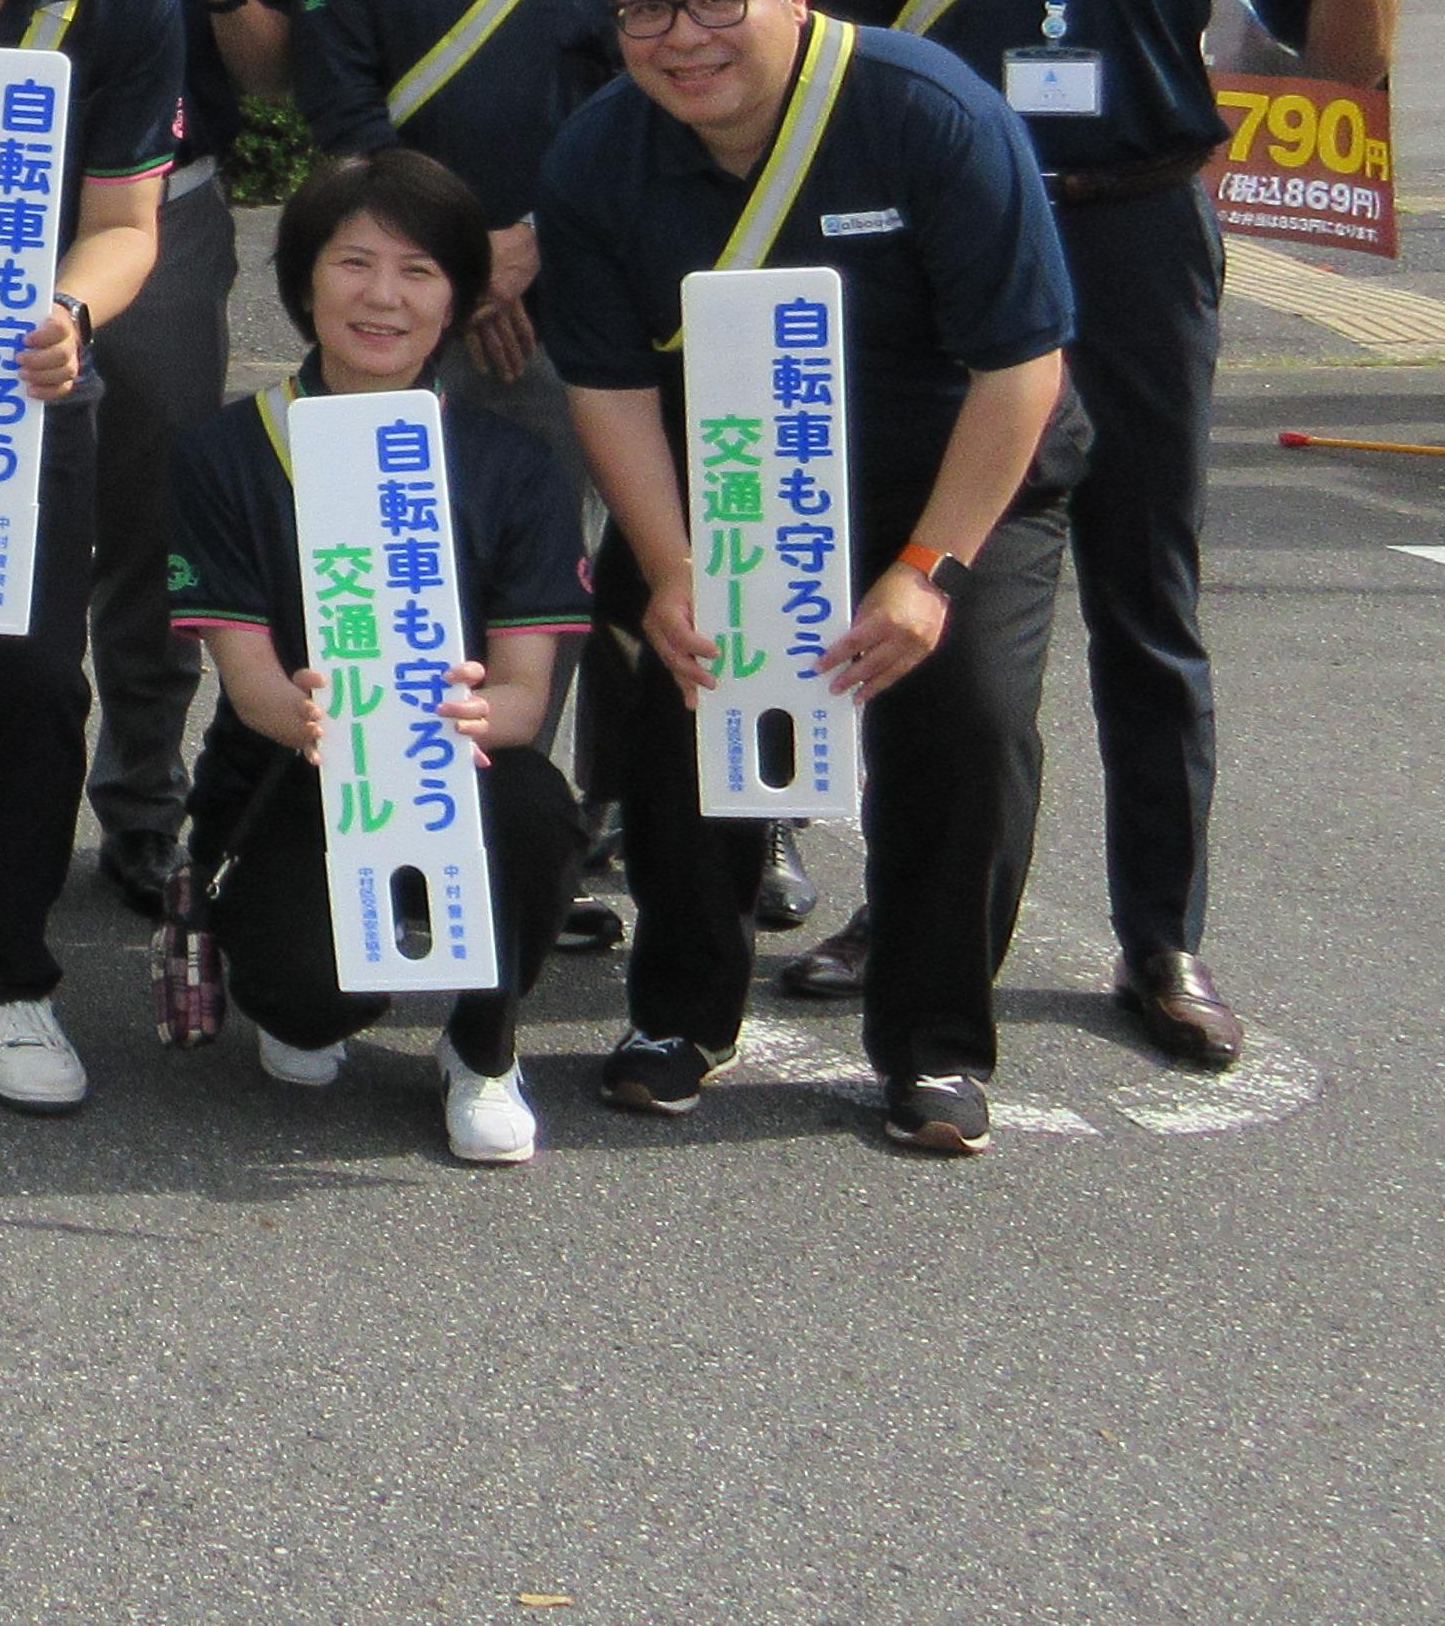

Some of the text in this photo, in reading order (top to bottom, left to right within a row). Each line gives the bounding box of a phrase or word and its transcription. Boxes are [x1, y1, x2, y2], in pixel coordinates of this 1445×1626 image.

[313, 544, 394, 834] 交通ルール
[375, 418, 457, 832] 自転車も守ろう
[700, 415, 767, 679] 交通ルール
